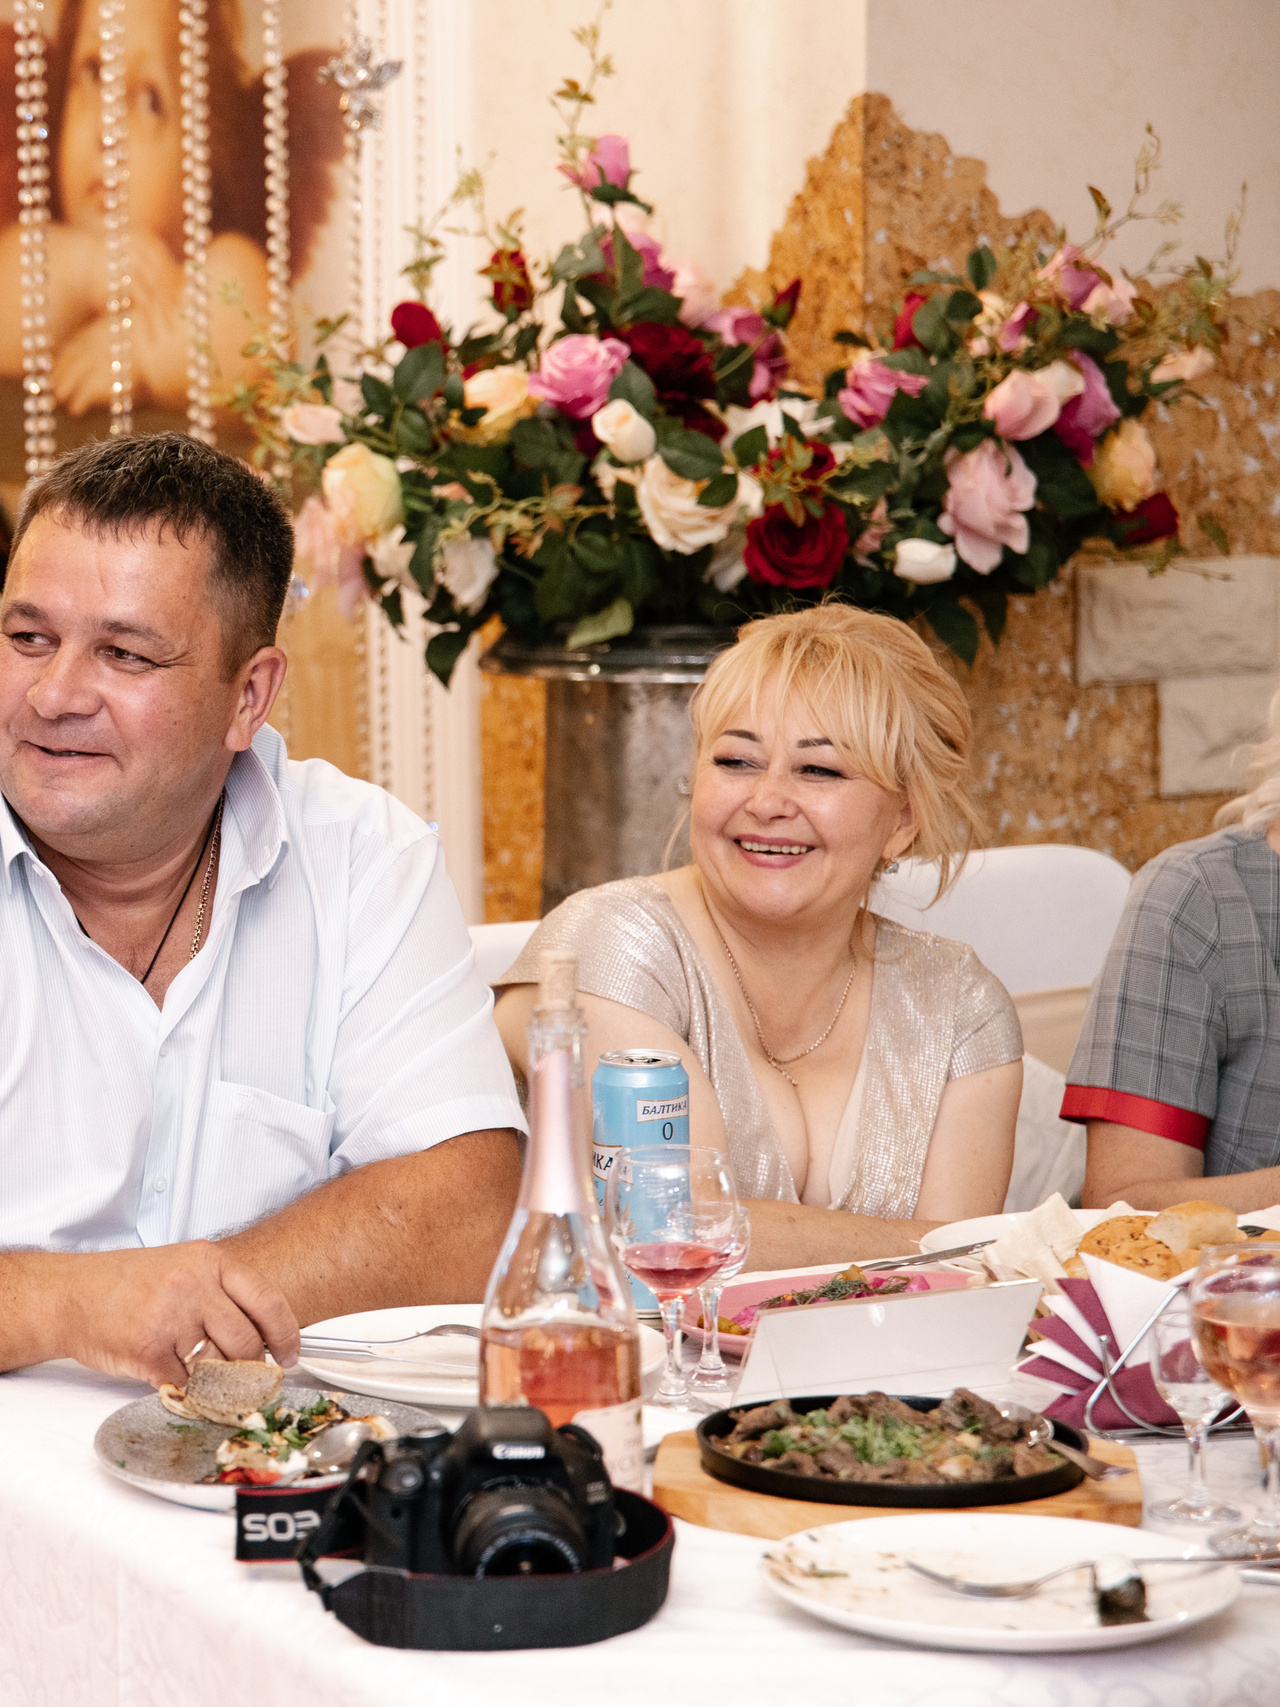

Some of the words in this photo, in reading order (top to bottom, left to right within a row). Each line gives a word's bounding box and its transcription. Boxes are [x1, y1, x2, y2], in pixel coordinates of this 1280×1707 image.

[641, 1100, 687, 1115] БАЛТИКА
[662, 1121, 674, 1141] 0
[491, 1443, 546, 1460] Canon
